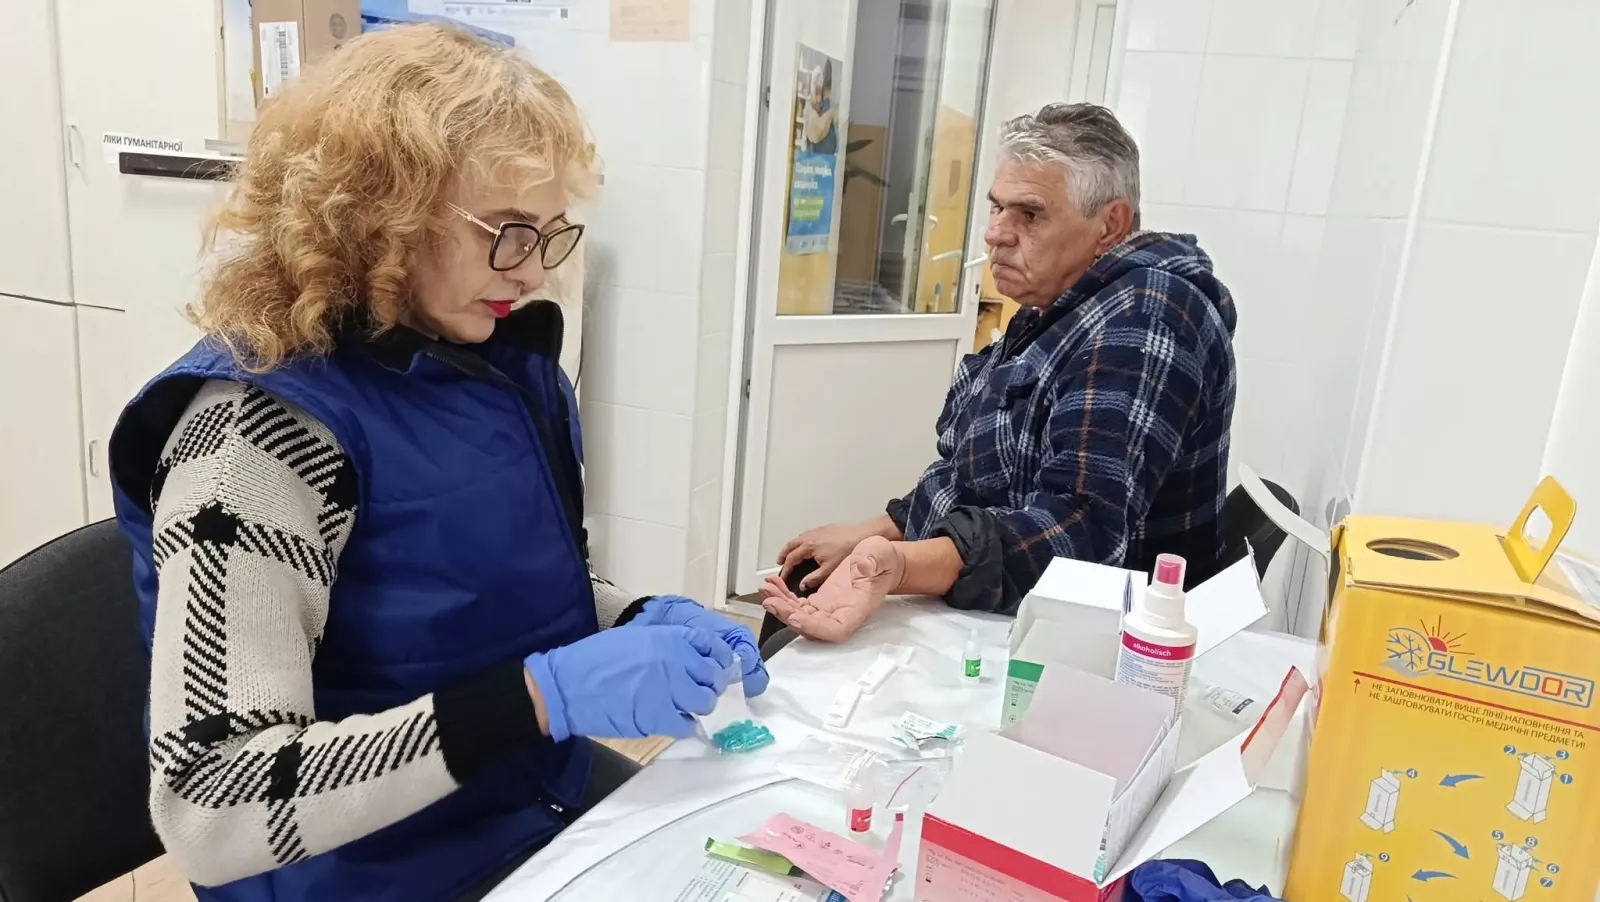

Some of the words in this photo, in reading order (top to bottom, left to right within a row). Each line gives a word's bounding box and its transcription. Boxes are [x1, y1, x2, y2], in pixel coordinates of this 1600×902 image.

[103, 134, 122, 145] ЛІКИ
[123, 137, 183, 152] ГУМАНІТАРНОЇ
[1427, 651, 1587, 702] GLEWDOR
[1369, 691, 1381, 700] НЕ
[1383, 694, 1452, 718] ЗАШТОВХУВАТИ
[1453, 711, 1485, 726] ГОСТРІ
[1485, 719, 1529, 737] МЕДИЧНІ
[1530, 729, 1586, 750] ПРЕДМЕТИ!
[1371, 682, 1383, 691] НЕ
[1385, 686, 1453, 708] ЗАПОВНЮВАТИ
[1454, 702, 1481, 715] ВИЩЕ
[1481, 708, 1505, 720] ЛІНІЇ
[1504, 714, 1571, 736] НАПОВНЕННЯ
[1573, 729, 1585, 739] ТА
